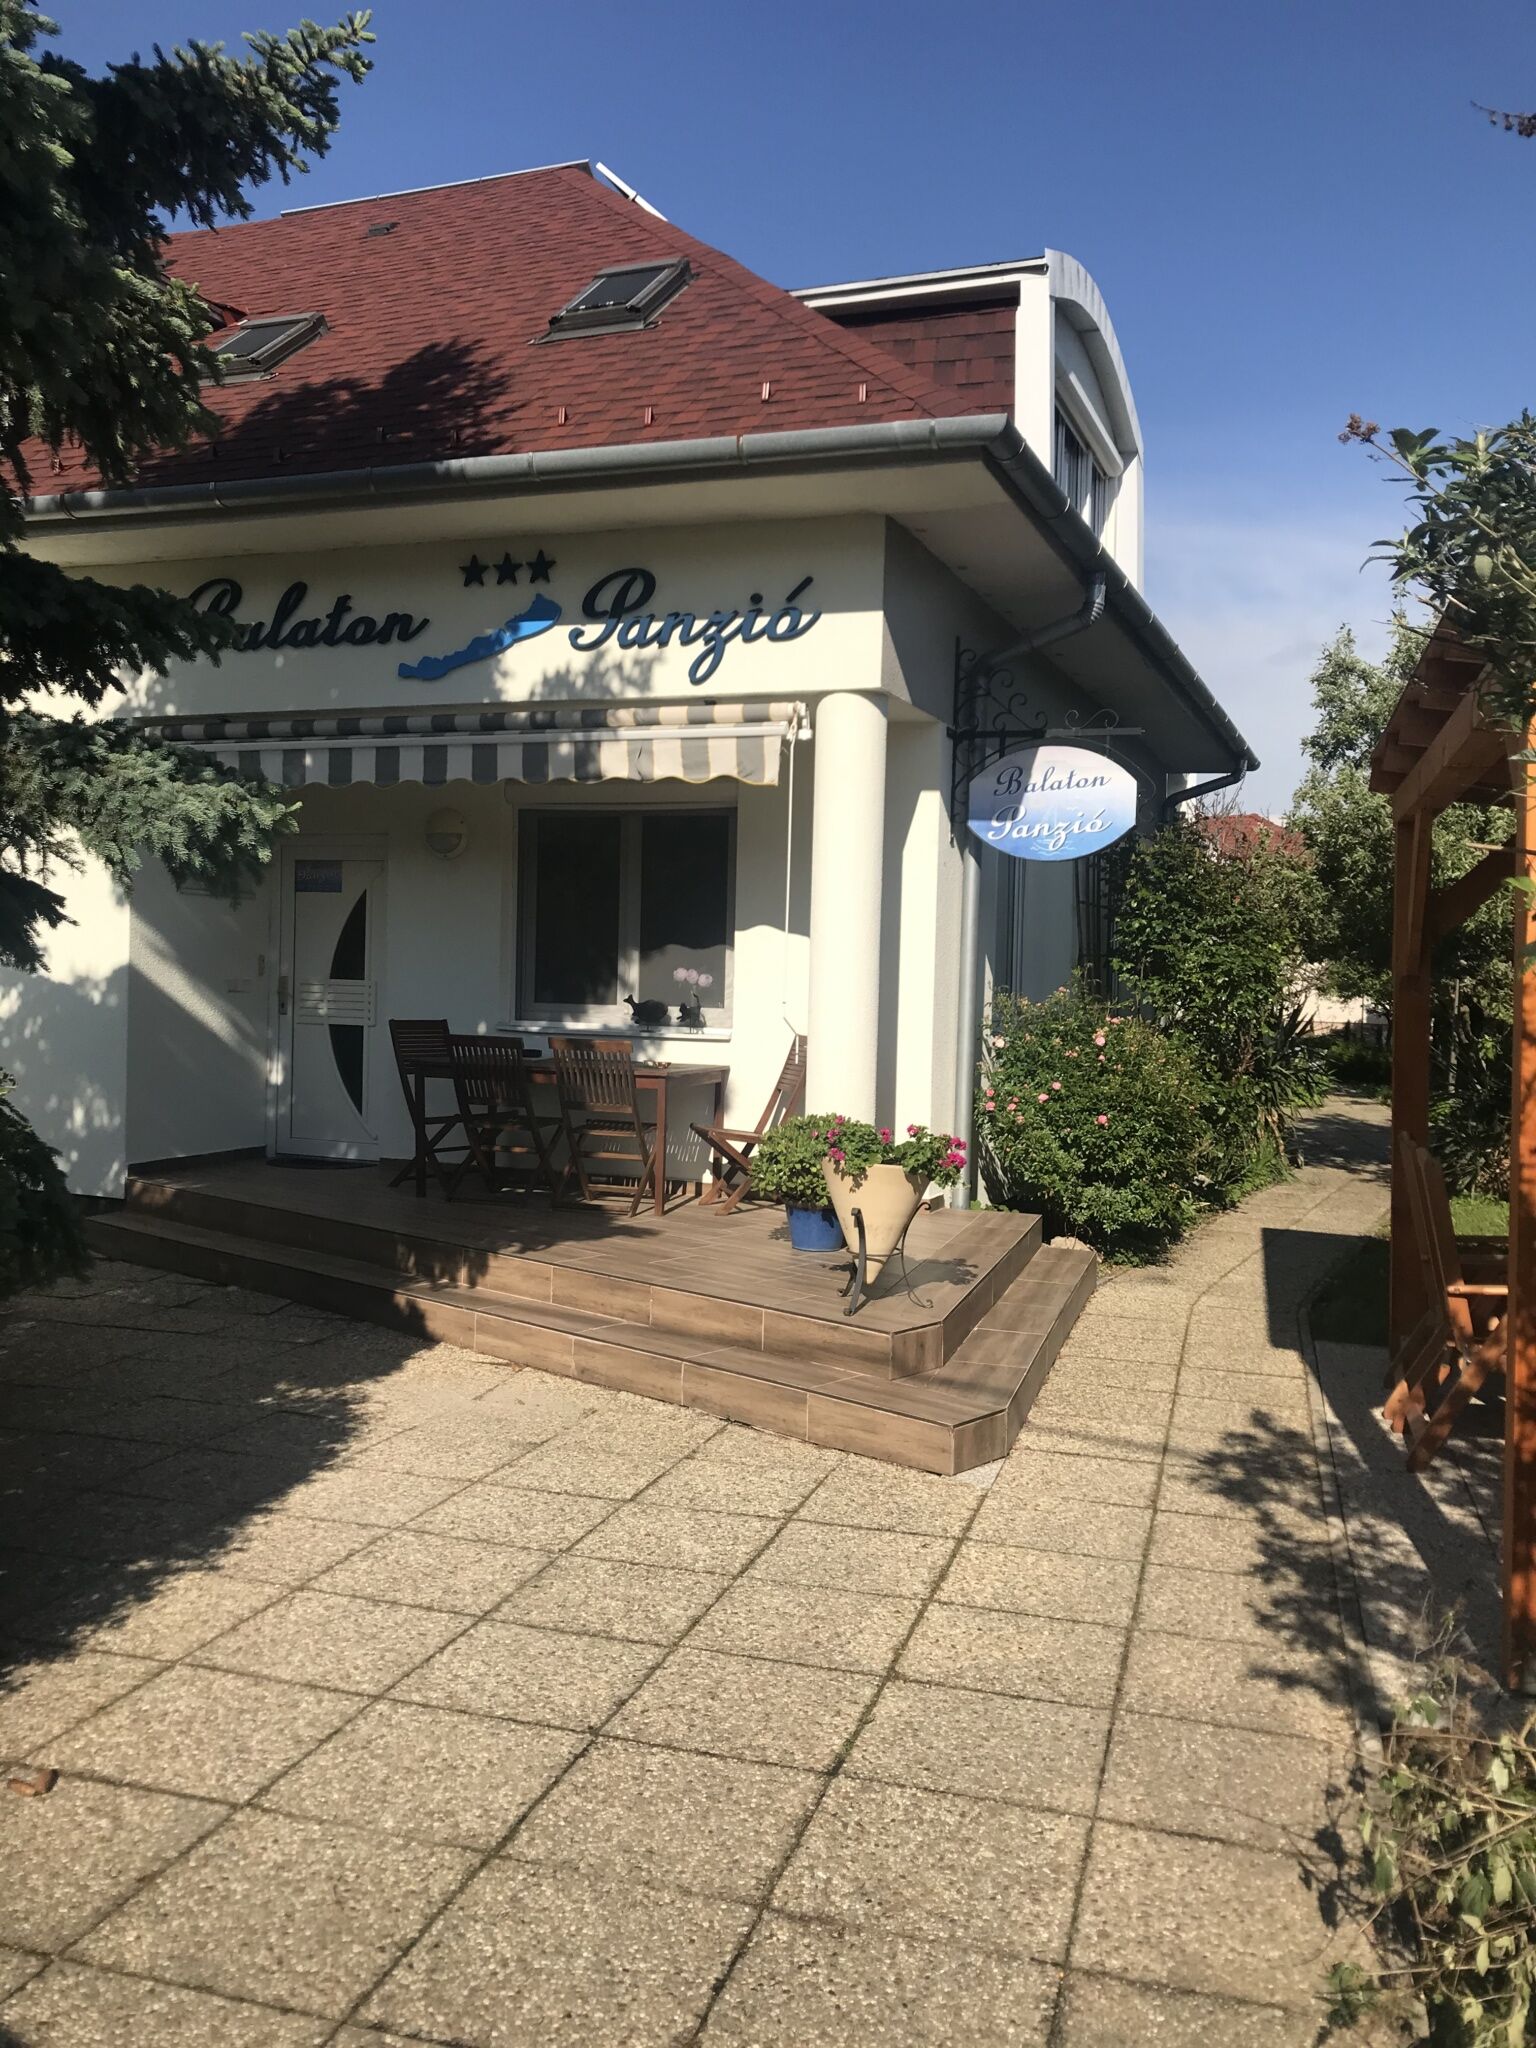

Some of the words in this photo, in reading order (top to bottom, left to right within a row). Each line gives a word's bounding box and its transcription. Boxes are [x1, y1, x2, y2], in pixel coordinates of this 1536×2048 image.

[568, 567, 822, 686] Panzió
[993, 766, 1111, 796] Balaton
[988, 805, 1112, 850] Panzió
